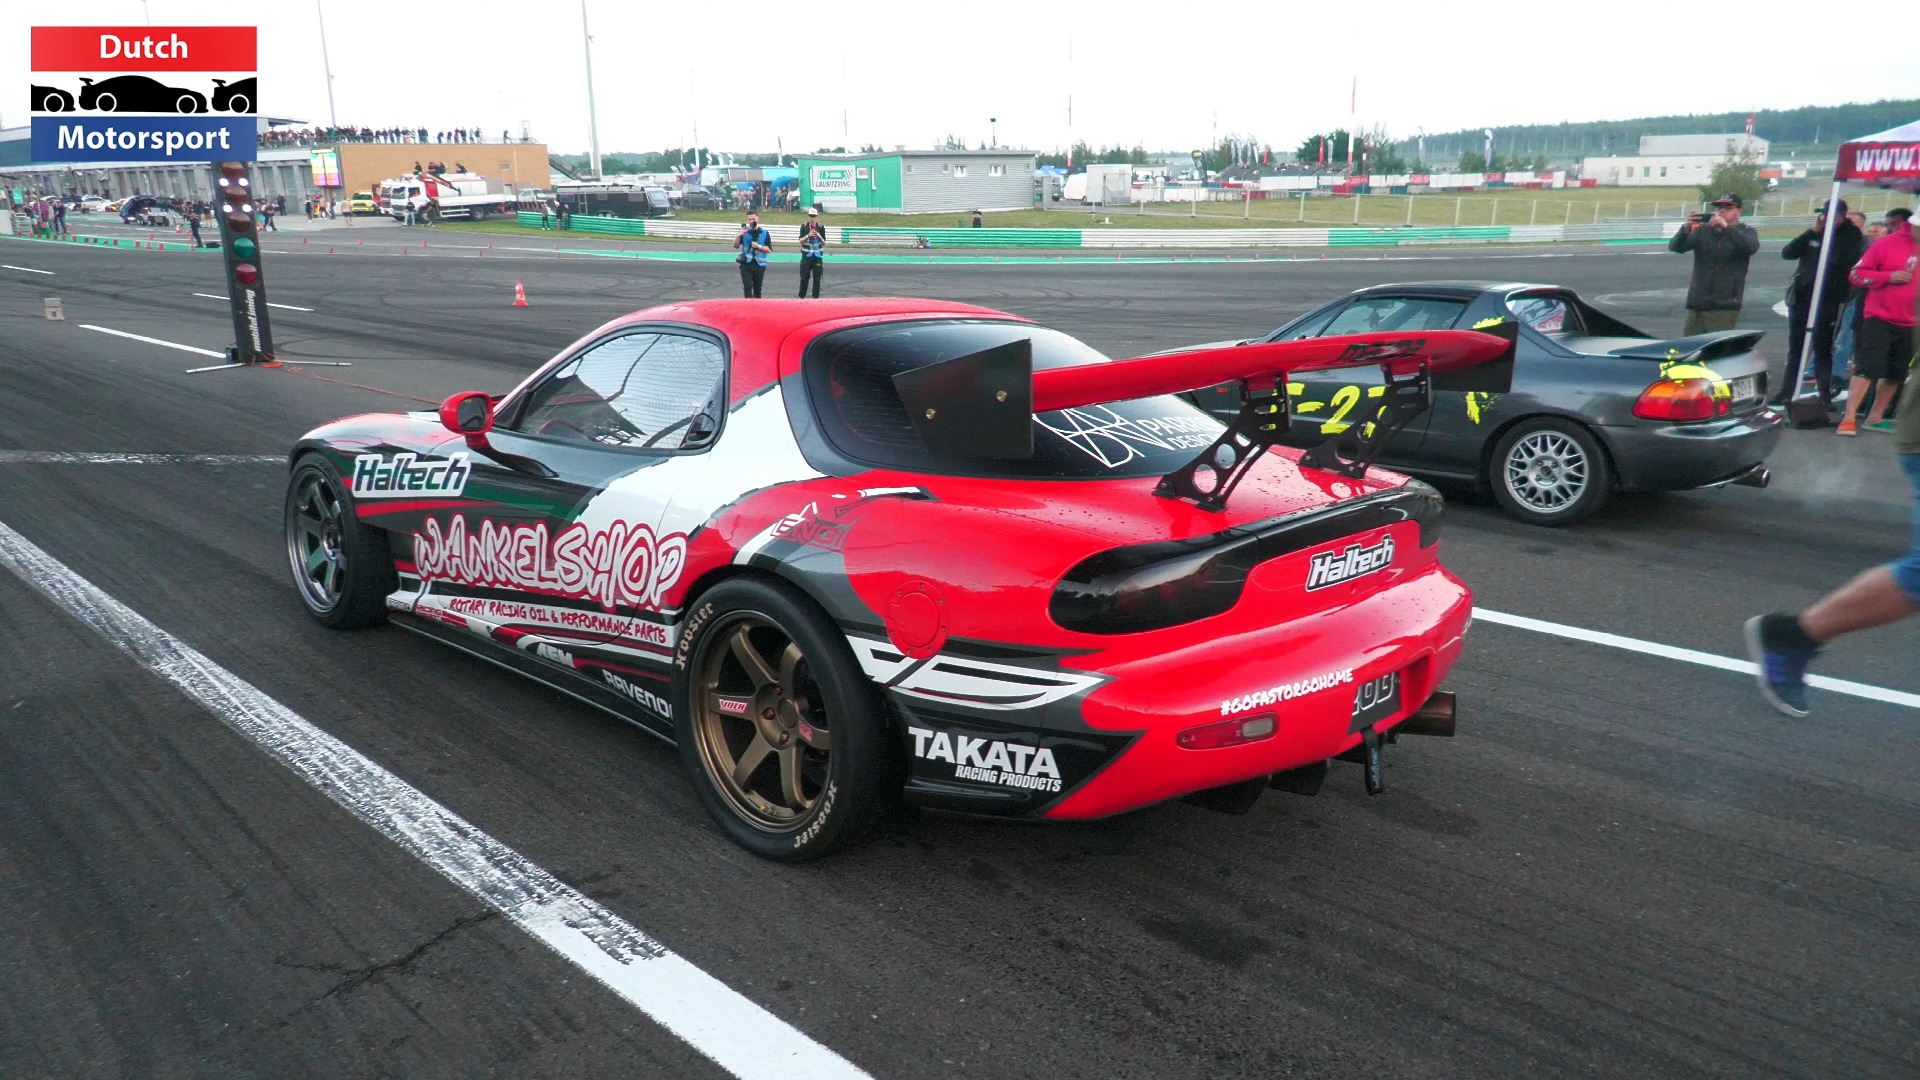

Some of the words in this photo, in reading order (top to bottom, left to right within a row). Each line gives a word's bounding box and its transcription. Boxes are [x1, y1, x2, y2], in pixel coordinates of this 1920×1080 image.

[815, 180, 851, 188] LAUSITZRING
[1855, 148, 1920, 172] WWW.
[353, 456, 468, 492] Haltech
[413, 513, 689, 609] WANKELSHOP
[1308, 536, 1395, 588] Haltech
[449, 598, 486, 616] ROTARY
[488, 600, 527, 620] RACING
[529, 606, 549, 623] OIL
[550, 611, 559, 624] &
[560, 611, 632, 637] PERFORMANCE
[634, 623, 666, 643] PARTS
[674, 602, 714, 671] Hoosier
[1220, 668, 1354, 716] #GOFASTORGOHOME
[908, 726, 1060, 779] TAKATA
[955, 764, 999, 783] RACING
[998, 771, 1063, 792] PRODUCTS
[793, 779, 838, 849] Hoosier
